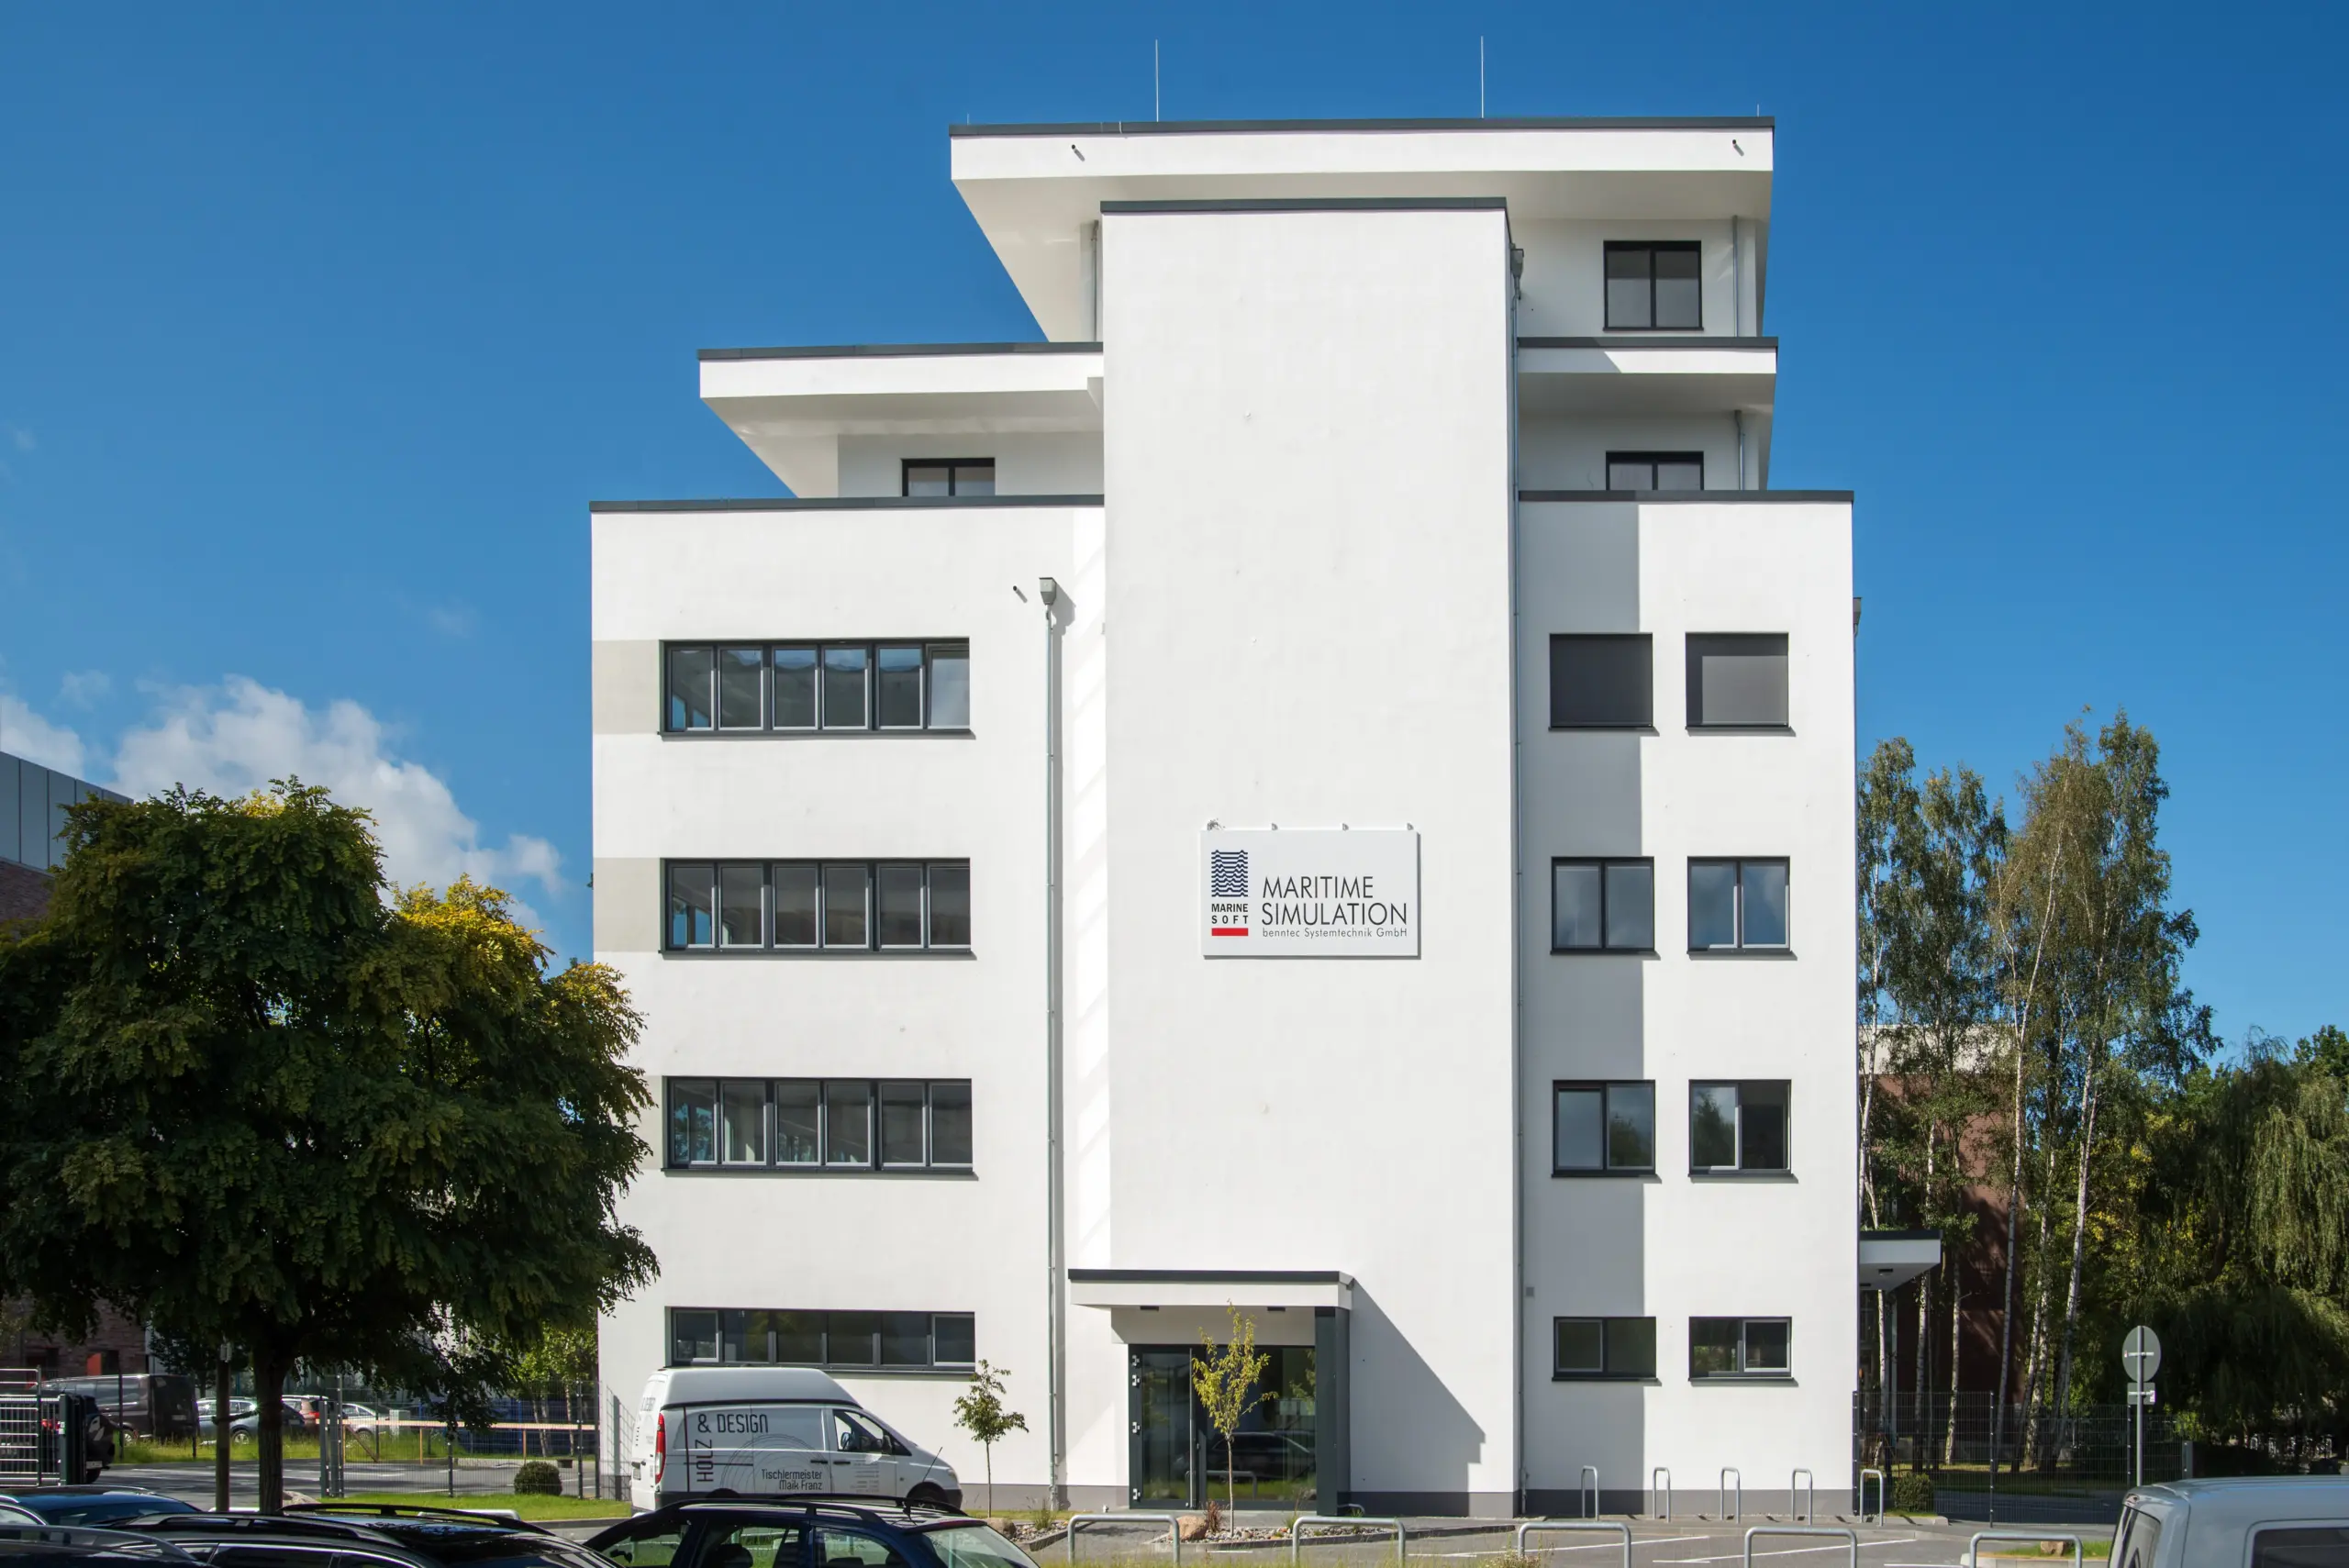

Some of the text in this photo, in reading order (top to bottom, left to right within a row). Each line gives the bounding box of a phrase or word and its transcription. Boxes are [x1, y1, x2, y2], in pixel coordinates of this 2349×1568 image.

[1263, 876, 1374, 899] MARITIME
[1211, 903, 1249, 913] MARINE
[1262, 902, 1408, 926] SIMULATION
[1211, 915, 1249, 924] SOFT
[1263, 927, 1408, 940] benntec Systemtechnik GmbH
[697, 1414, 769, 1433] & DESIGN
[695, 1439, 714, 1483] HOLZ
[761, 1469, 823, 1480] Tischlermeister
[778, 1480, 823, 1491] Maik Franz
